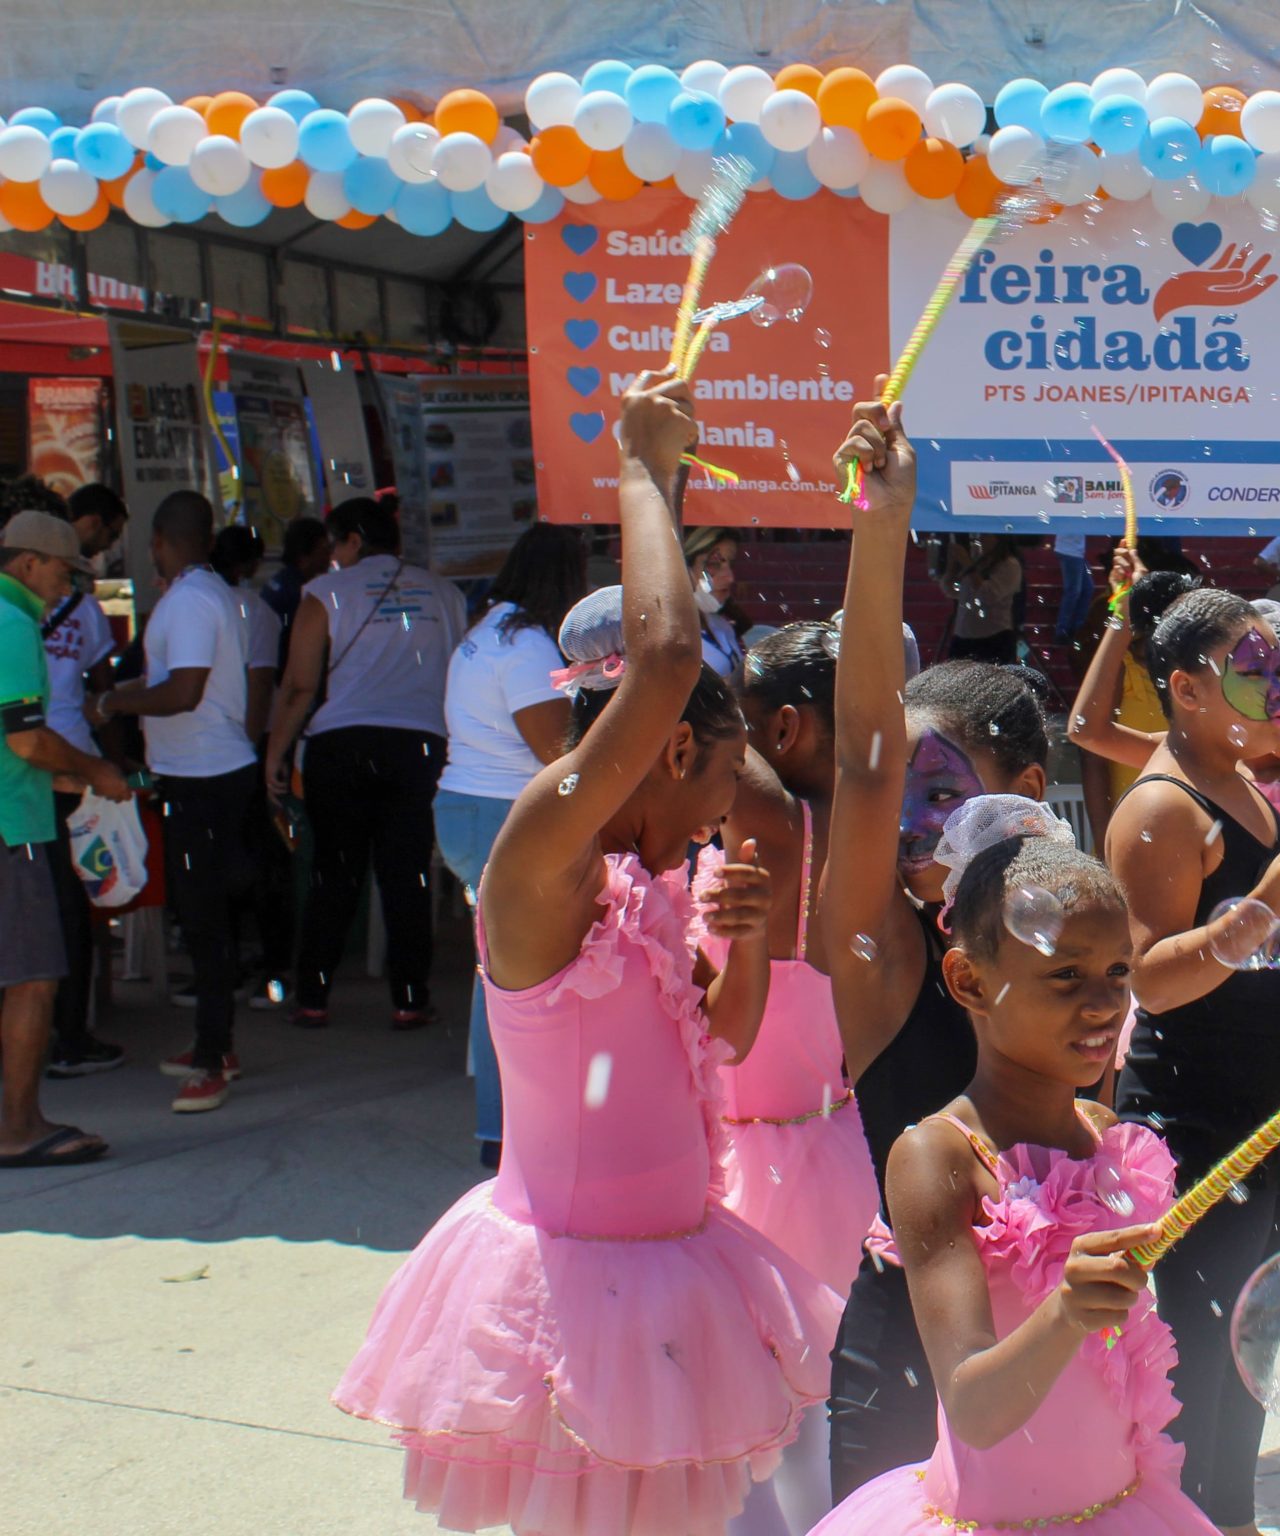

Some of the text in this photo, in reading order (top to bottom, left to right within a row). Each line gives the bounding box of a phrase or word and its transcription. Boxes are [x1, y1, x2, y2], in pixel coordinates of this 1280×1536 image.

[959, 248, 1150, 305] feira
[605, 277, 690, 304] Laze
[983, 313, 1251, 372] cidadã
[694, 374, 854, 401] ambiente
[984, 383, 1251, 405] PTS JOANES/IPITANGA
[989, 485, 1037, 497] IPITANGA
[1085, 481, 1125, 491] BAHI
[1208, 486, 1280, 502] CONDER
